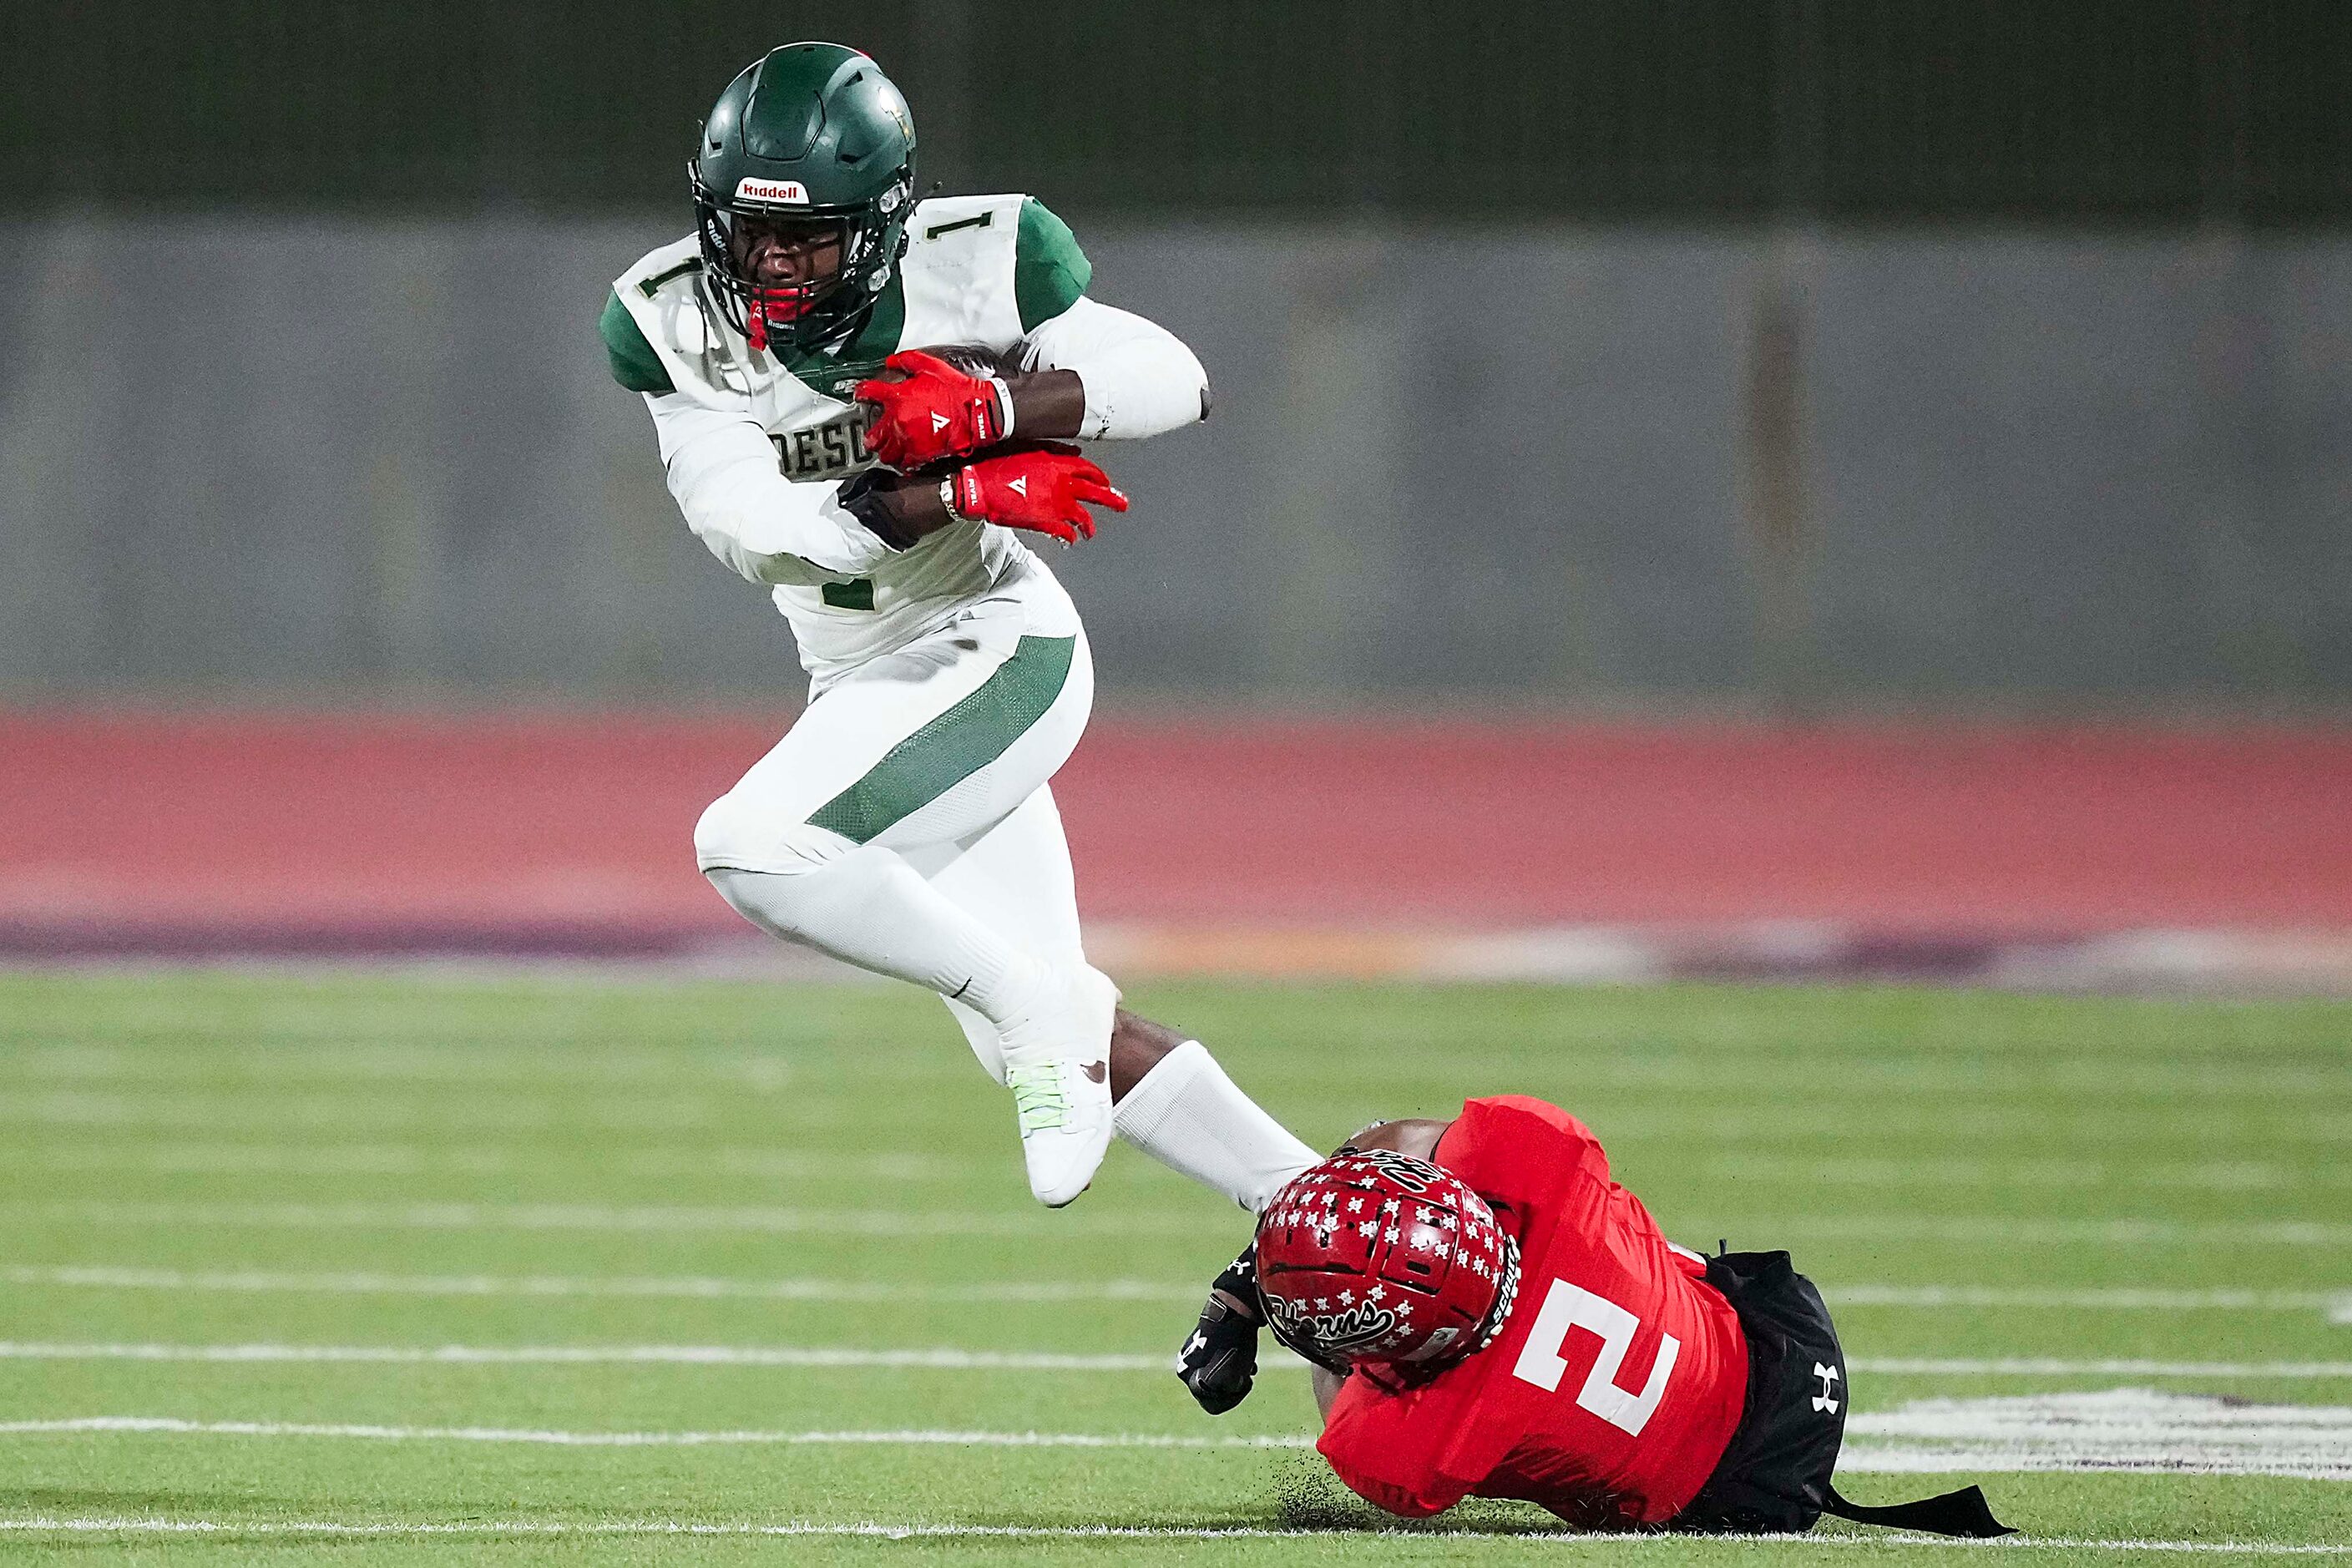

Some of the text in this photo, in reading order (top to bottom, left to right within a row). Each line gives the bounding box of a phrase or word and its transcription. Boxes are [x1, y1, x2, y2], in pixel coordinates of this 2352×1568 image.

[743, 184, 797, 199] Riddell
[924, 210, 994, 242] 1
[636, 255, 704, 299] 1
[1512, 1277, 1682, 1438] 2
